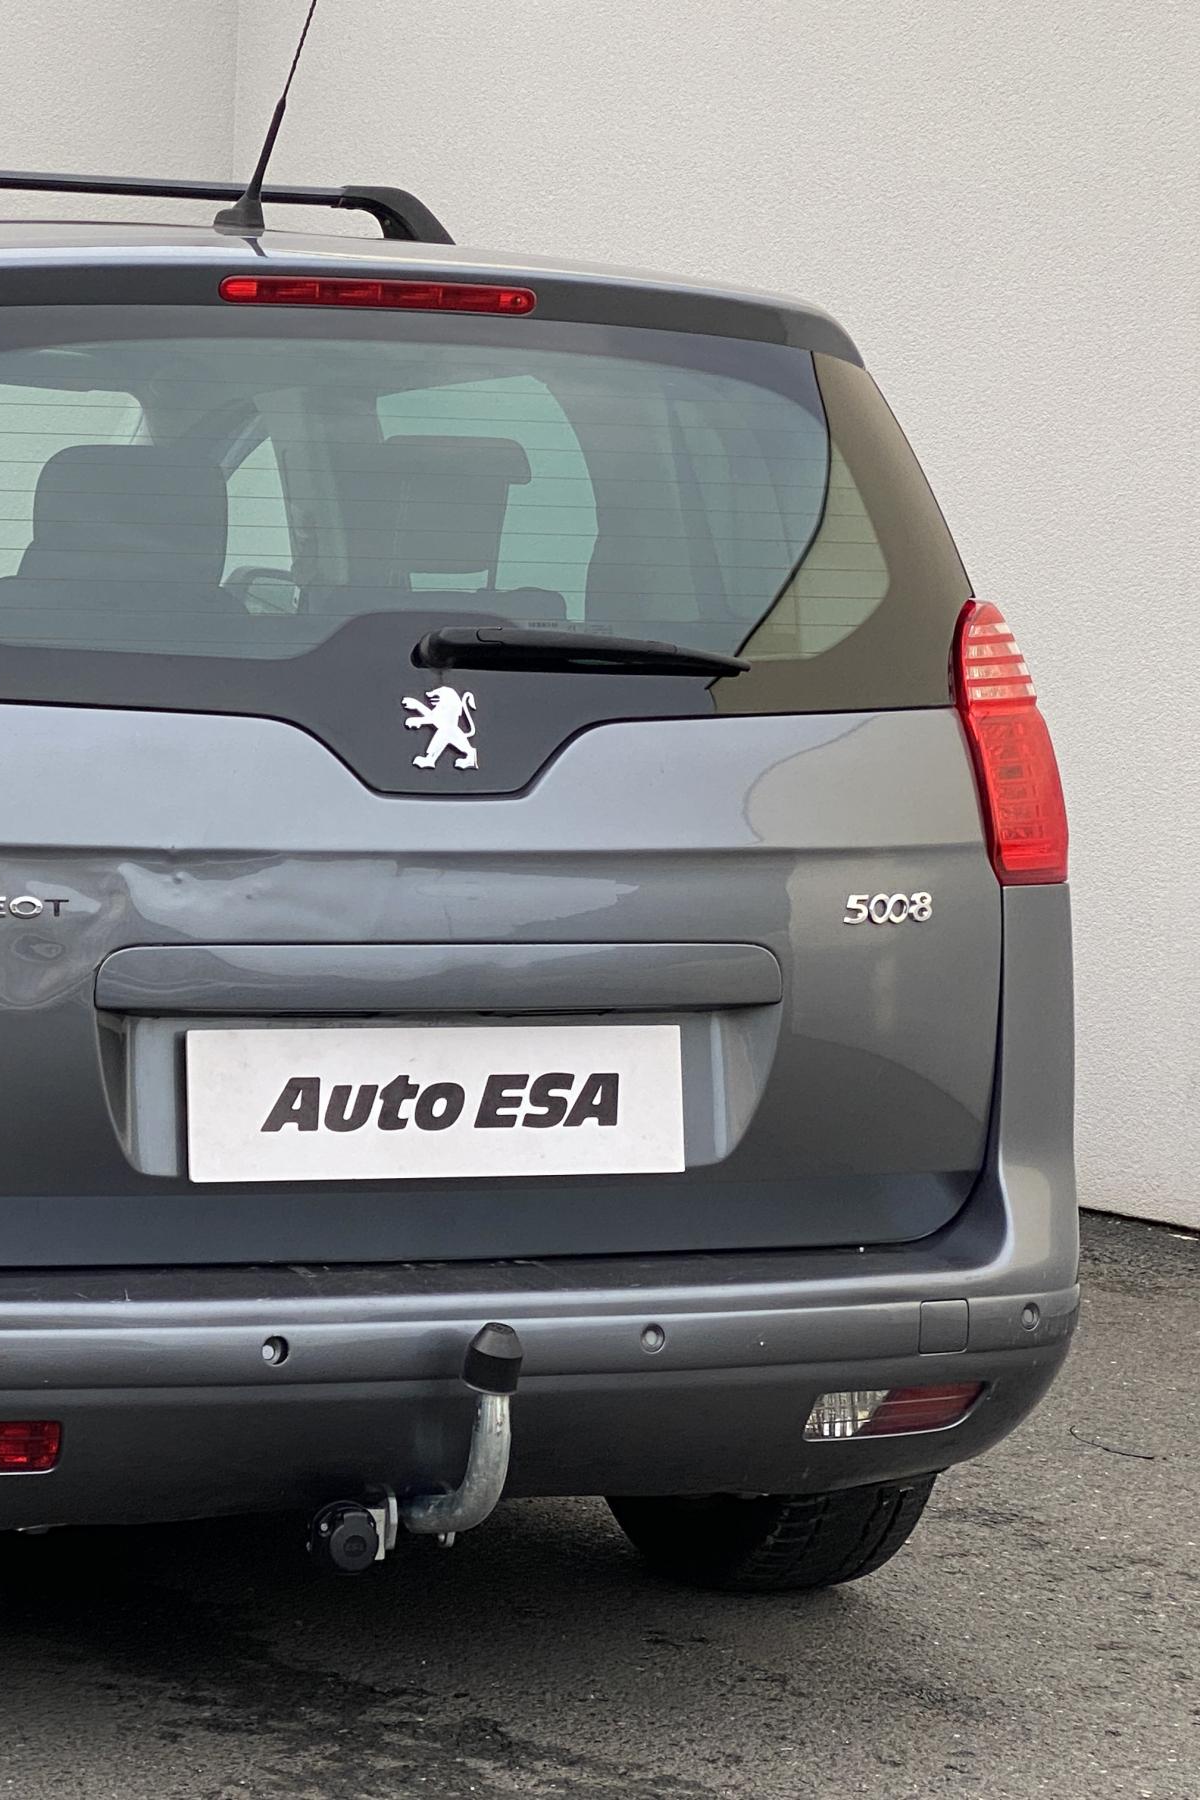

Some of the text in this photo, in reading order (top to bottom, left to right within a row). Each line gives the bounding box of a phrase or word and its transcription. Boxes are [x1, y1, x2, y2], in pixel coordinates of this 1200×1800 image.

[843, 891, 932, 924] 5008
[260, 1072, 619, 1132] Auto ESA
